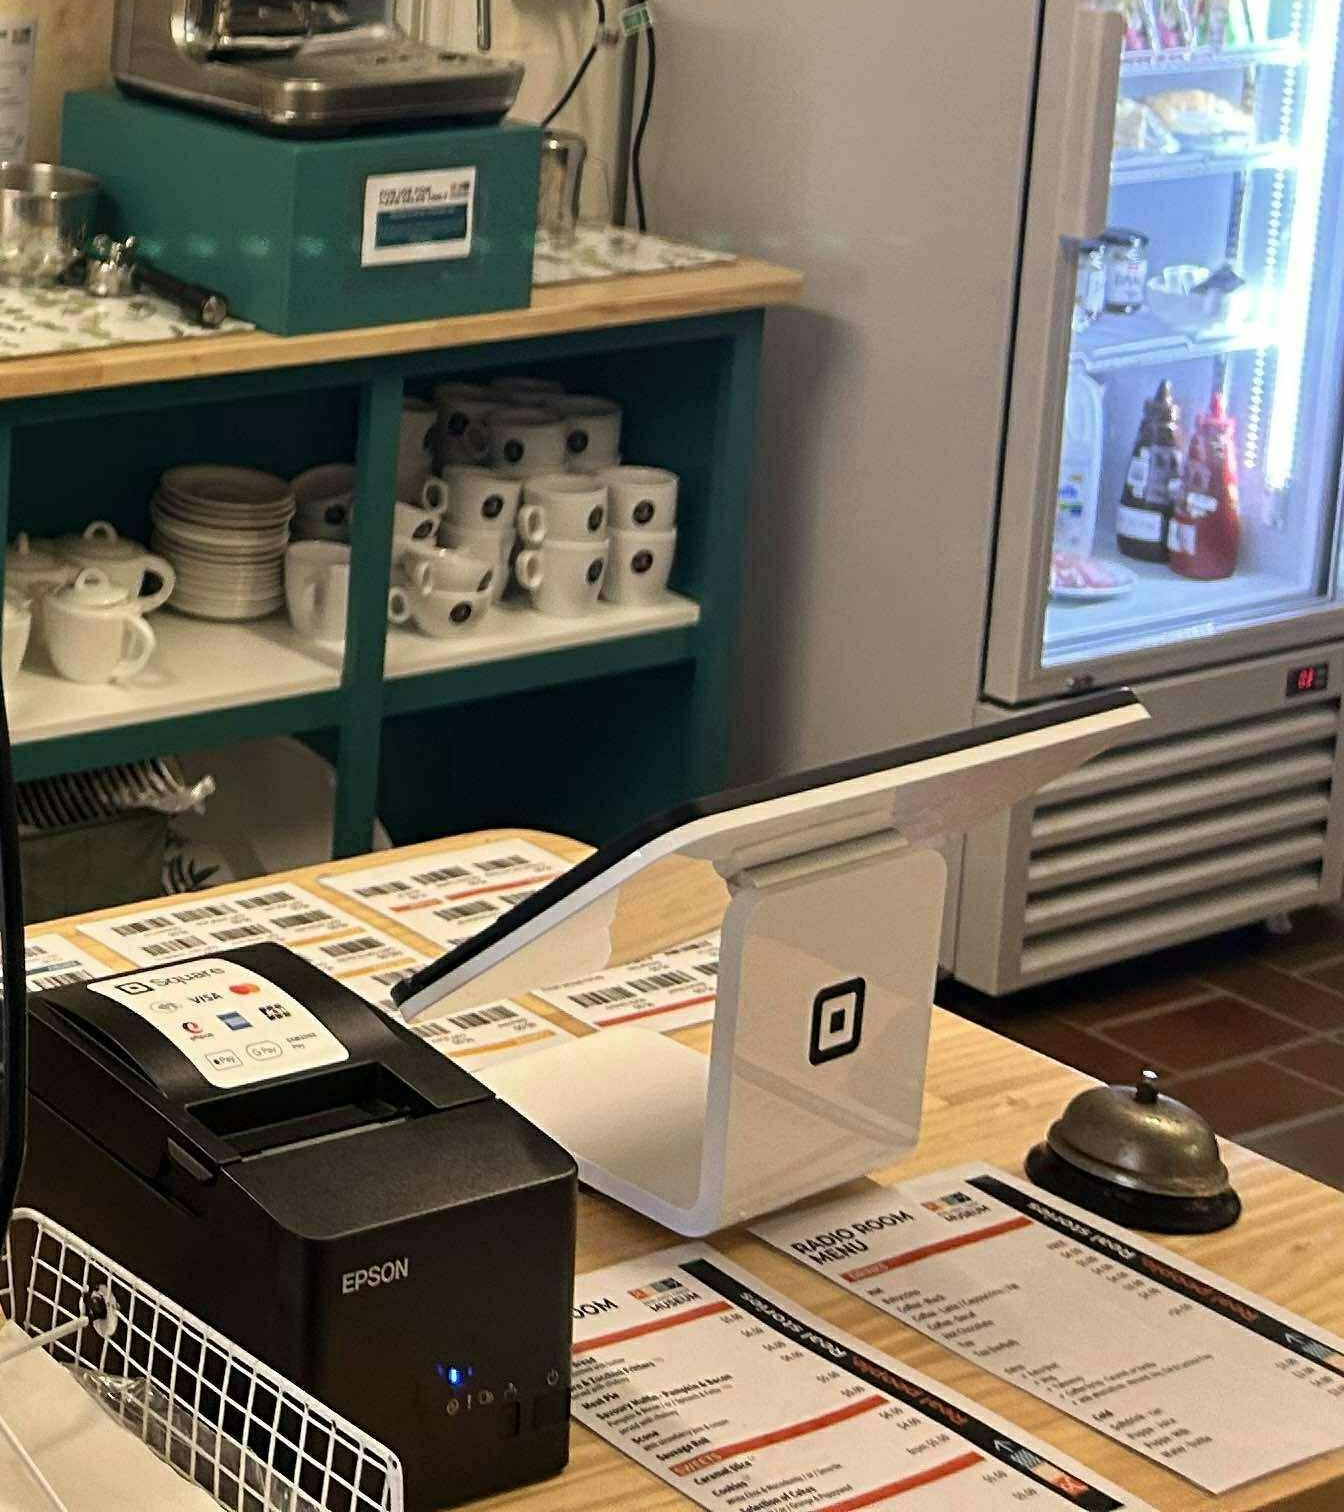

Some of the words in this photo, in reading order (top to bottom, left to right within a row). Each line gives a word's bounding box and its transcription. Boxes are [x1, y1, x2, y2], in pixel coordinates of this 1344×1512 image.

[149, 967, 226, 990] Square
[187, 991, 224, 1005] VISA
[219, 1055, 236, 1066] Pay
[790, 1227, 856, 1255] RADIO
[854, 1210, 915, 1235] ROOM
[809, 1238, 870, 1266] MENU
[341, 1256, 410, 1295] EPSON
[571, 1296, 618, 1320] OOM
[649, 1291, 703, 1314] MUSEUM
